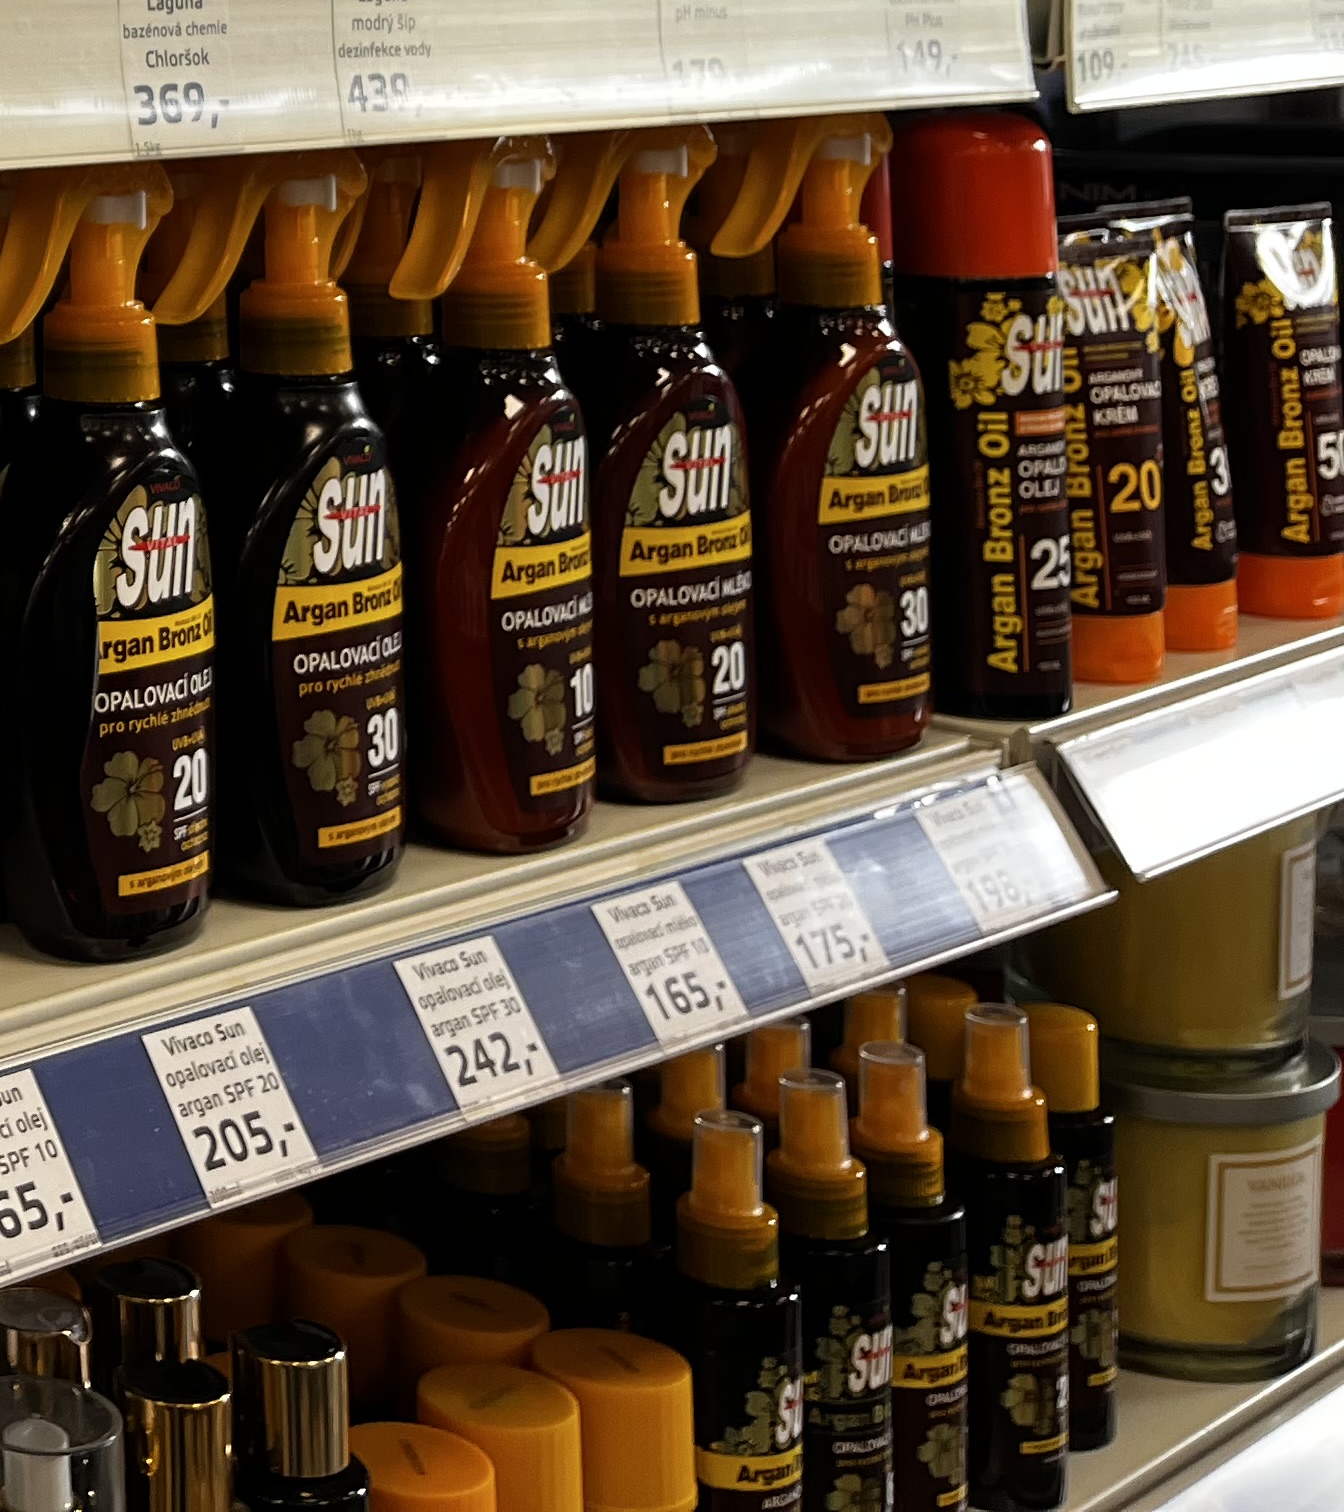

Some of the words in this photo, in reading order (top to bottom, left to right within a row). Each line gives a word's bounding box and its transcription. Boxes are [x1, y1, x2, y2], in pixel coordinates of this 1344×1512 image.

[122, 22, 182, 40] bazénová
[185, 20, 228, 37] chemie
[351, 13, 394, 34] modrý
[145, 47, 211, 69] Chloršok
[338, 41, 402, 60] dezinfekce
[133, 81, 230, 129] 369,-
[1092, 403, 1139, 427] KRÉM
[1277, 365, 1304, 451] Bronz
[1108, 458, 1162, 514] 20
[1030, 536, 1071, 592] 25
[283, 594, 350, 627] Argan
[353, 586, 392, 615] Bronz
[899, 587, 928, 638] 30
[92, 671, 190, 715] OPALOVACÍ
[570, 661, 595, 720] 10
[128, 710, 168, 735] rychlé
[367, 706, 400, 769] 30
[172, 747, 209, 812] 20
[239, 1043, 271, 1071] olej
[443, 1030, 539, 1088] 242,-
[222, 1078, 255, 1105] SPF
